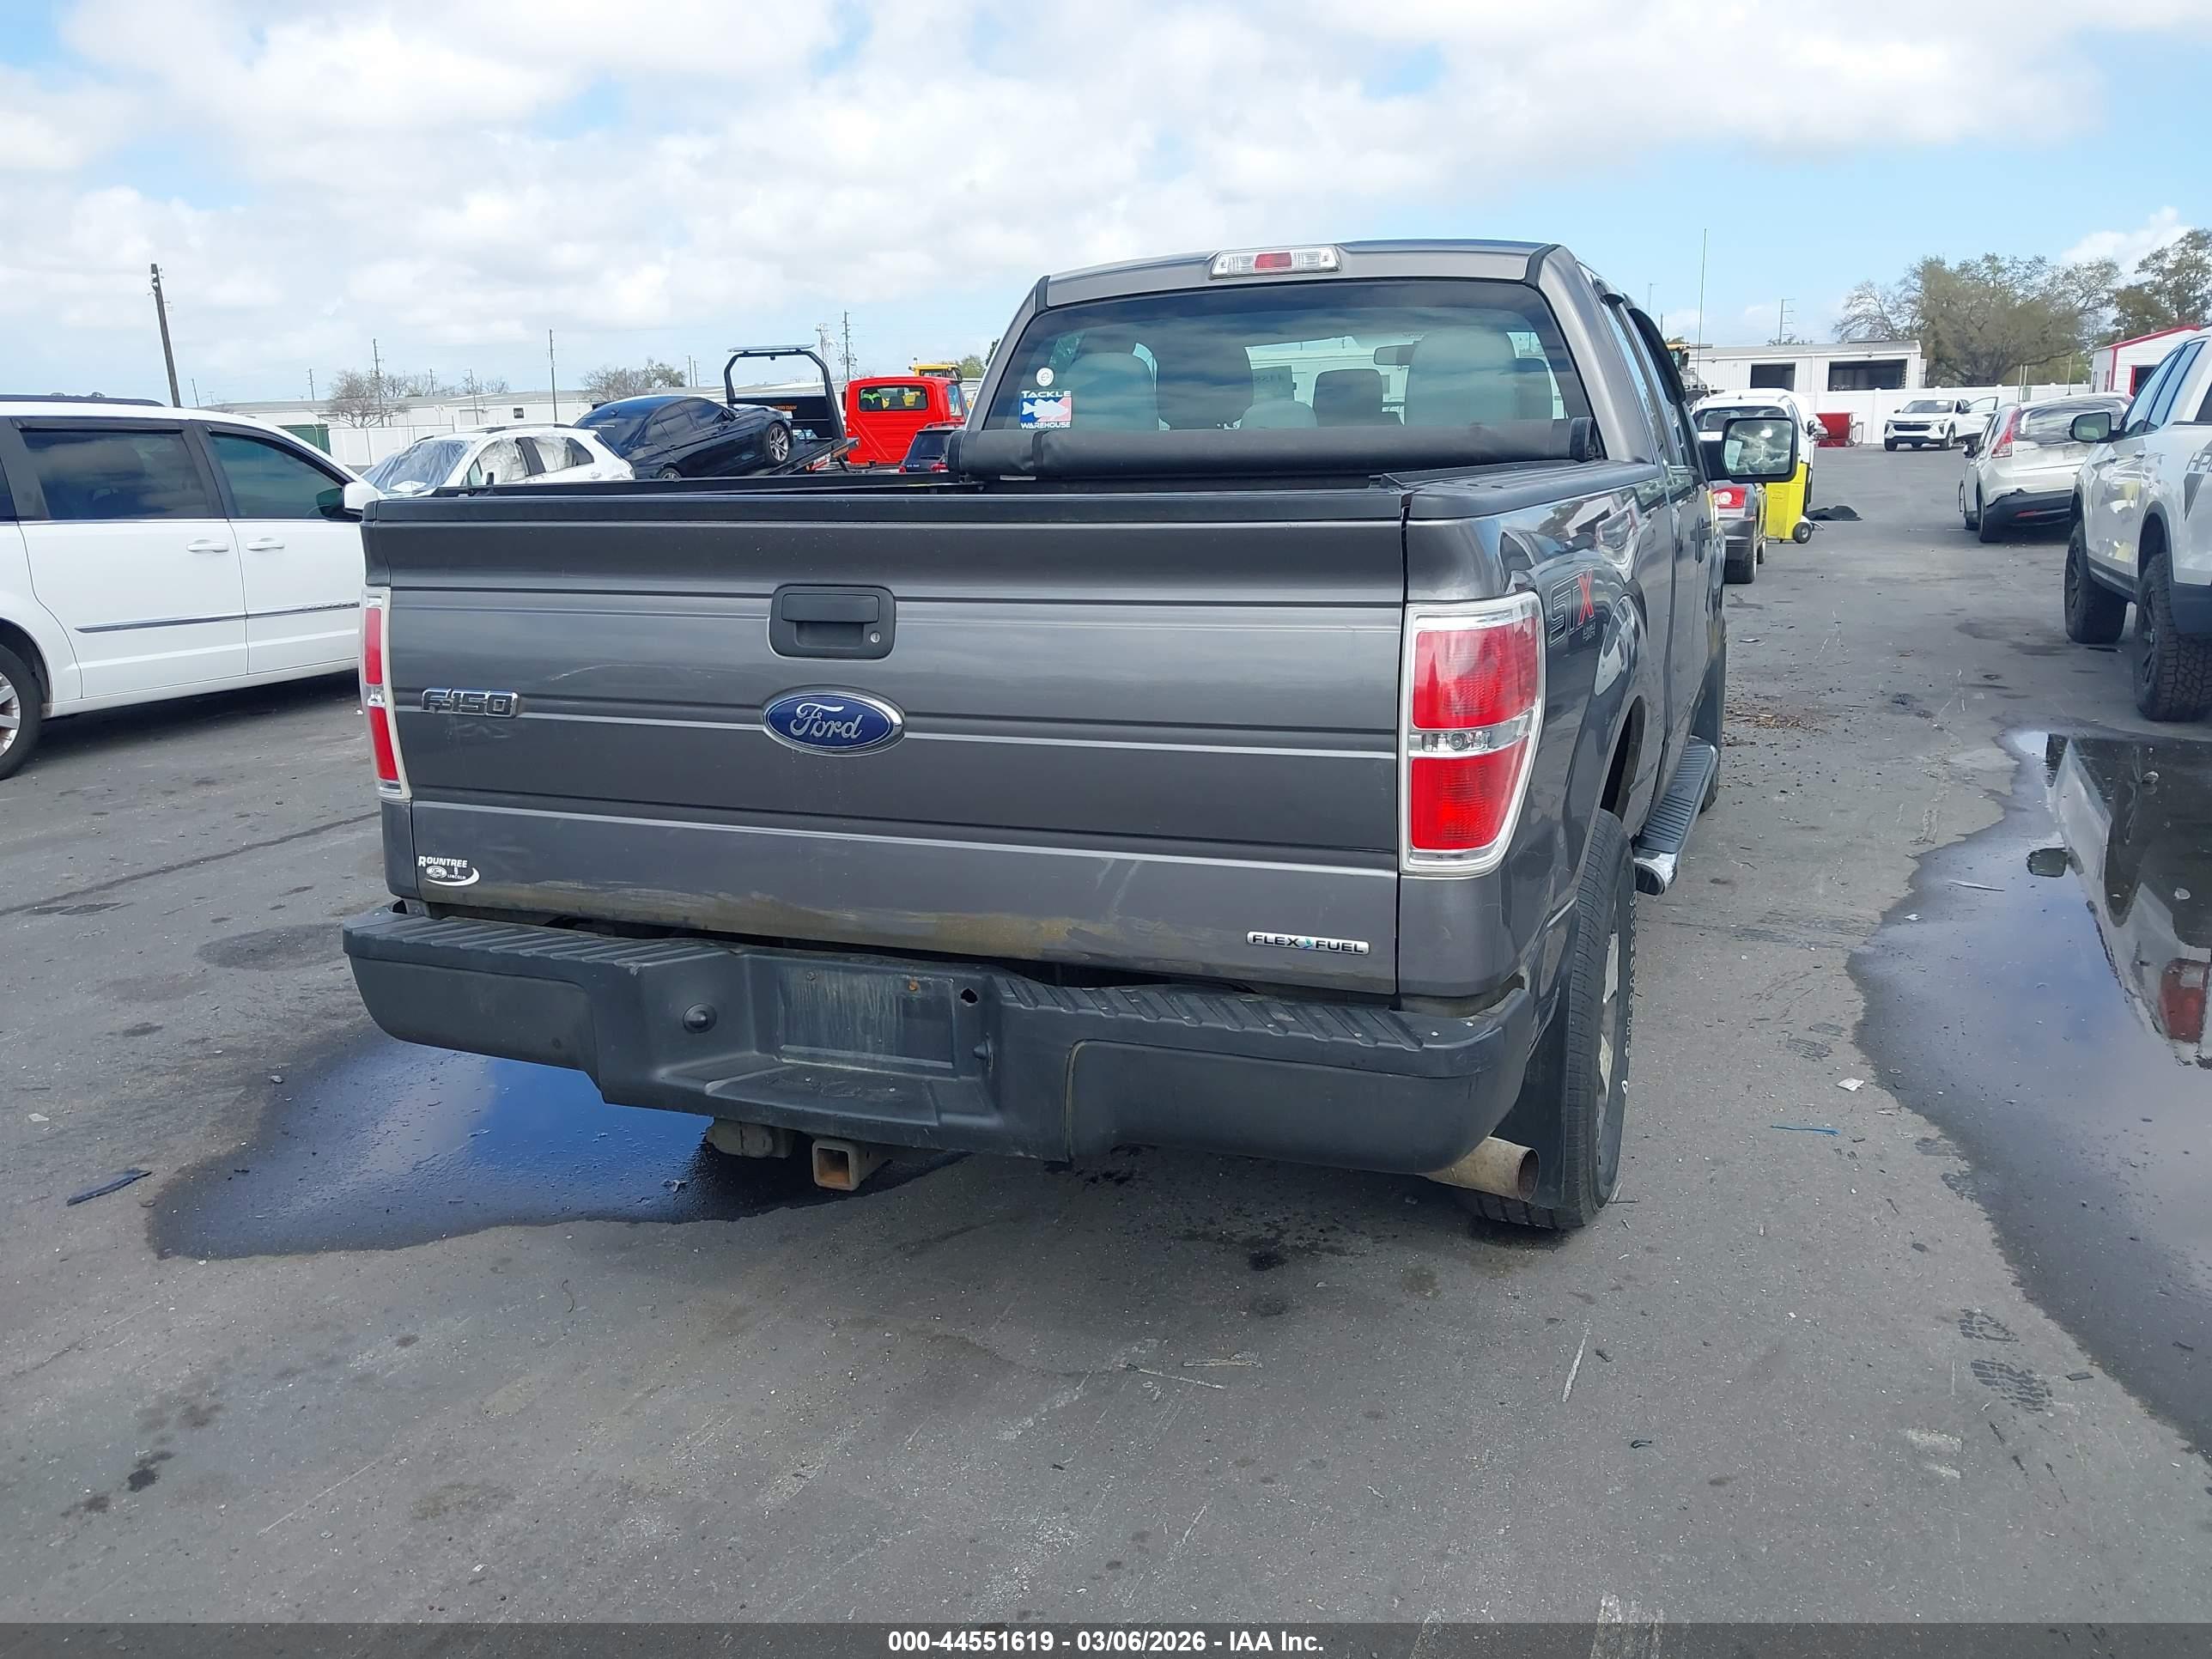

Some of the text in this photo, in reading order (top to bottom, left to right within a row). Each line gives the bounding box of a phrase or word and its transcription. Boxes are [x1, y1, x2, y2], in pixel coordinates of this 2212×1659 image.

[2185, 452, 2212, 472] HP
[1549, 563, 1595, 648] STX
[422, 688, 519, 717] F-150
[789, 702, 864, 739] Ford
[417, 855, 468, 868] ROUNTREE
[1252, 933, 1364, 953] FLEX FUEL
